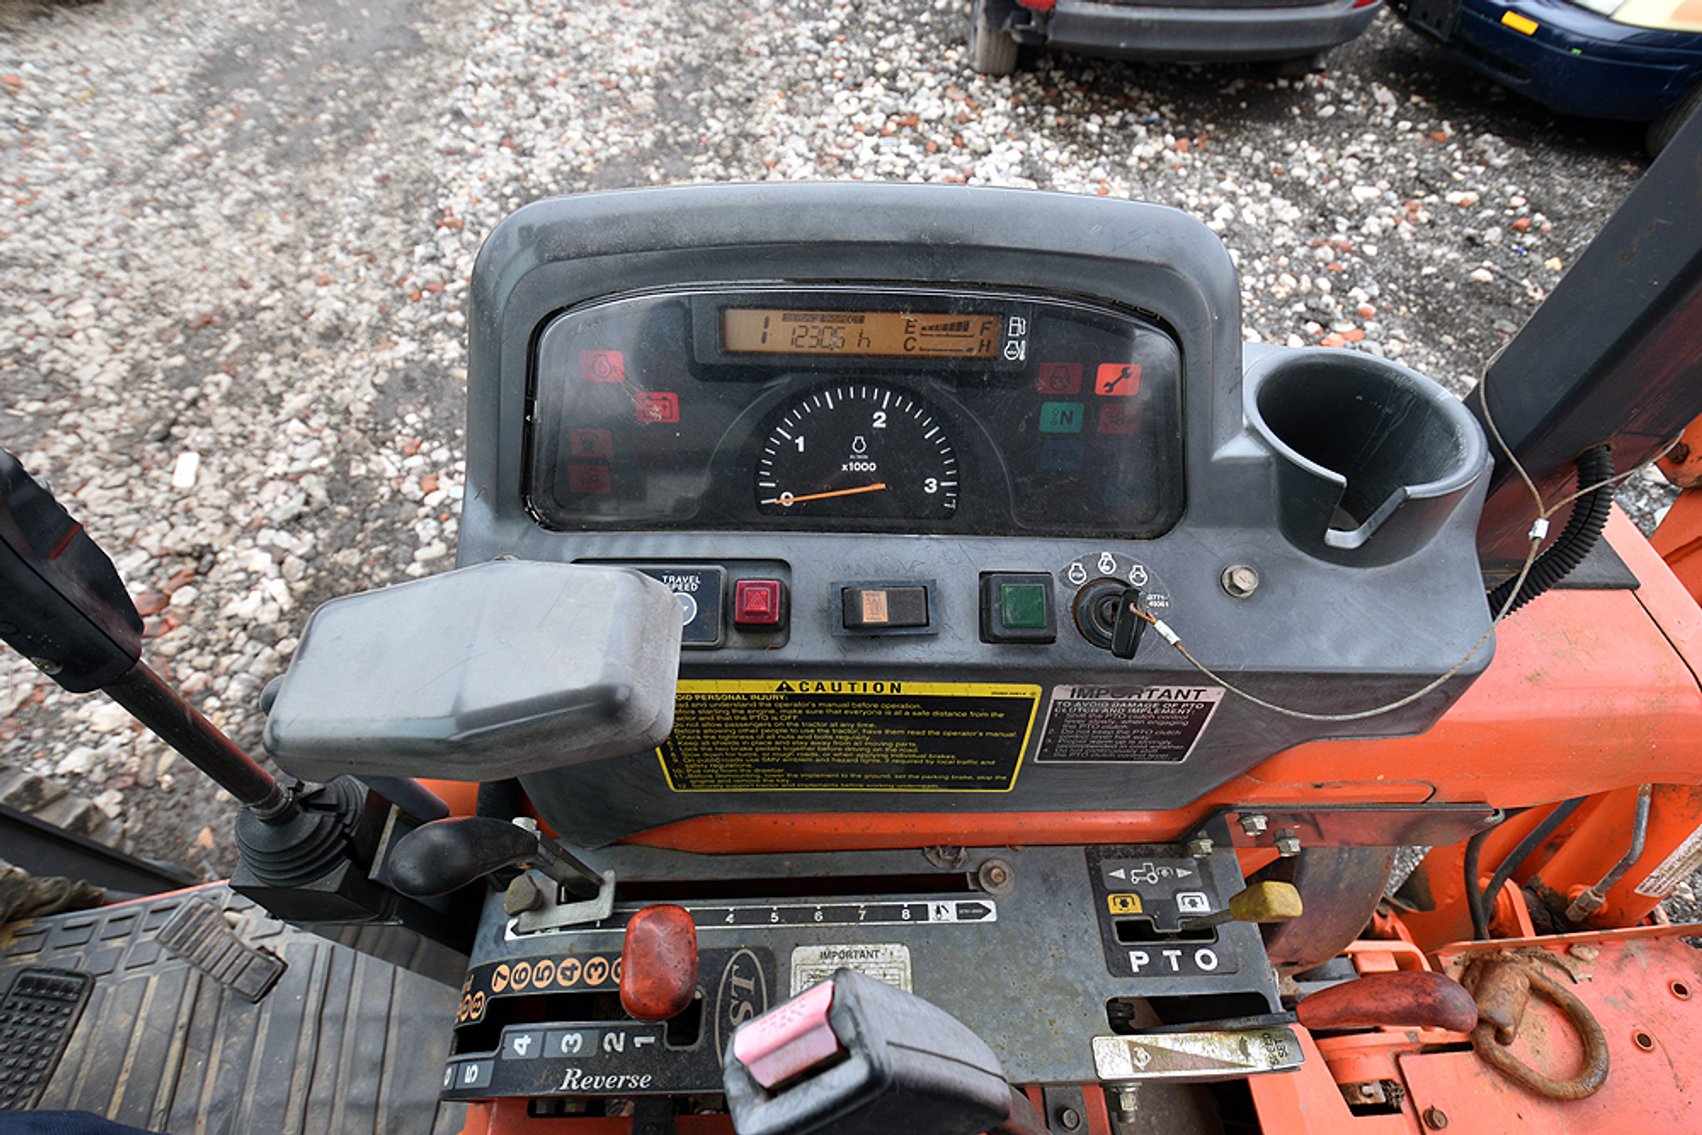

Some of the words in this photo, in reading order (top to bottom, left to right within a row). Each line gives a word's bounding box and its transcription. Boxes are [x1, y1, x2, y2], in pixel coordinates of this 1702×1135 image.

[904, 318, 918, 334] E
[979, 321, 993, 337] F
[903, 337, 917, 352] C
[978, 339, 991, 352] H
[872, 411, 887, 428] 2
[1060, 410, 1073, 425] N
[795, 436, 805, 452] 1
[841, 462, 877, 472] x1000
[923, 478, 938, 493] 3
[780, 492, 794, 507] 0
[662, 575, 701, 584] TRAVEL
[670, 582, 699, 591] PEED
[799, 682, 902, 694] CAUTION
[725, 913, 735, 923] 4
[770, 913, 780, 923] 5
[814, 911, 824, 921] 6
[858, 910, 867, 920] 7
[902, 909, 911, 920] 8
[819, 949, 880, 960] IMPORTANT
[1128, 949, 1218, 973] PTO
[536, 965, 553, 982] 5
[560, 963, 578, 982] 4
[587, 961, 606, 980] 3
[513, 1034, 532, 1056] 4
[561, 1033, 583, 1053] 3
[603, 1032, 625, 1052] 2
[633, 1036, 656, 1048] 1
[464, 1064, 479, 1083] 5
[559, 1068, 652, 1090] Reverse
